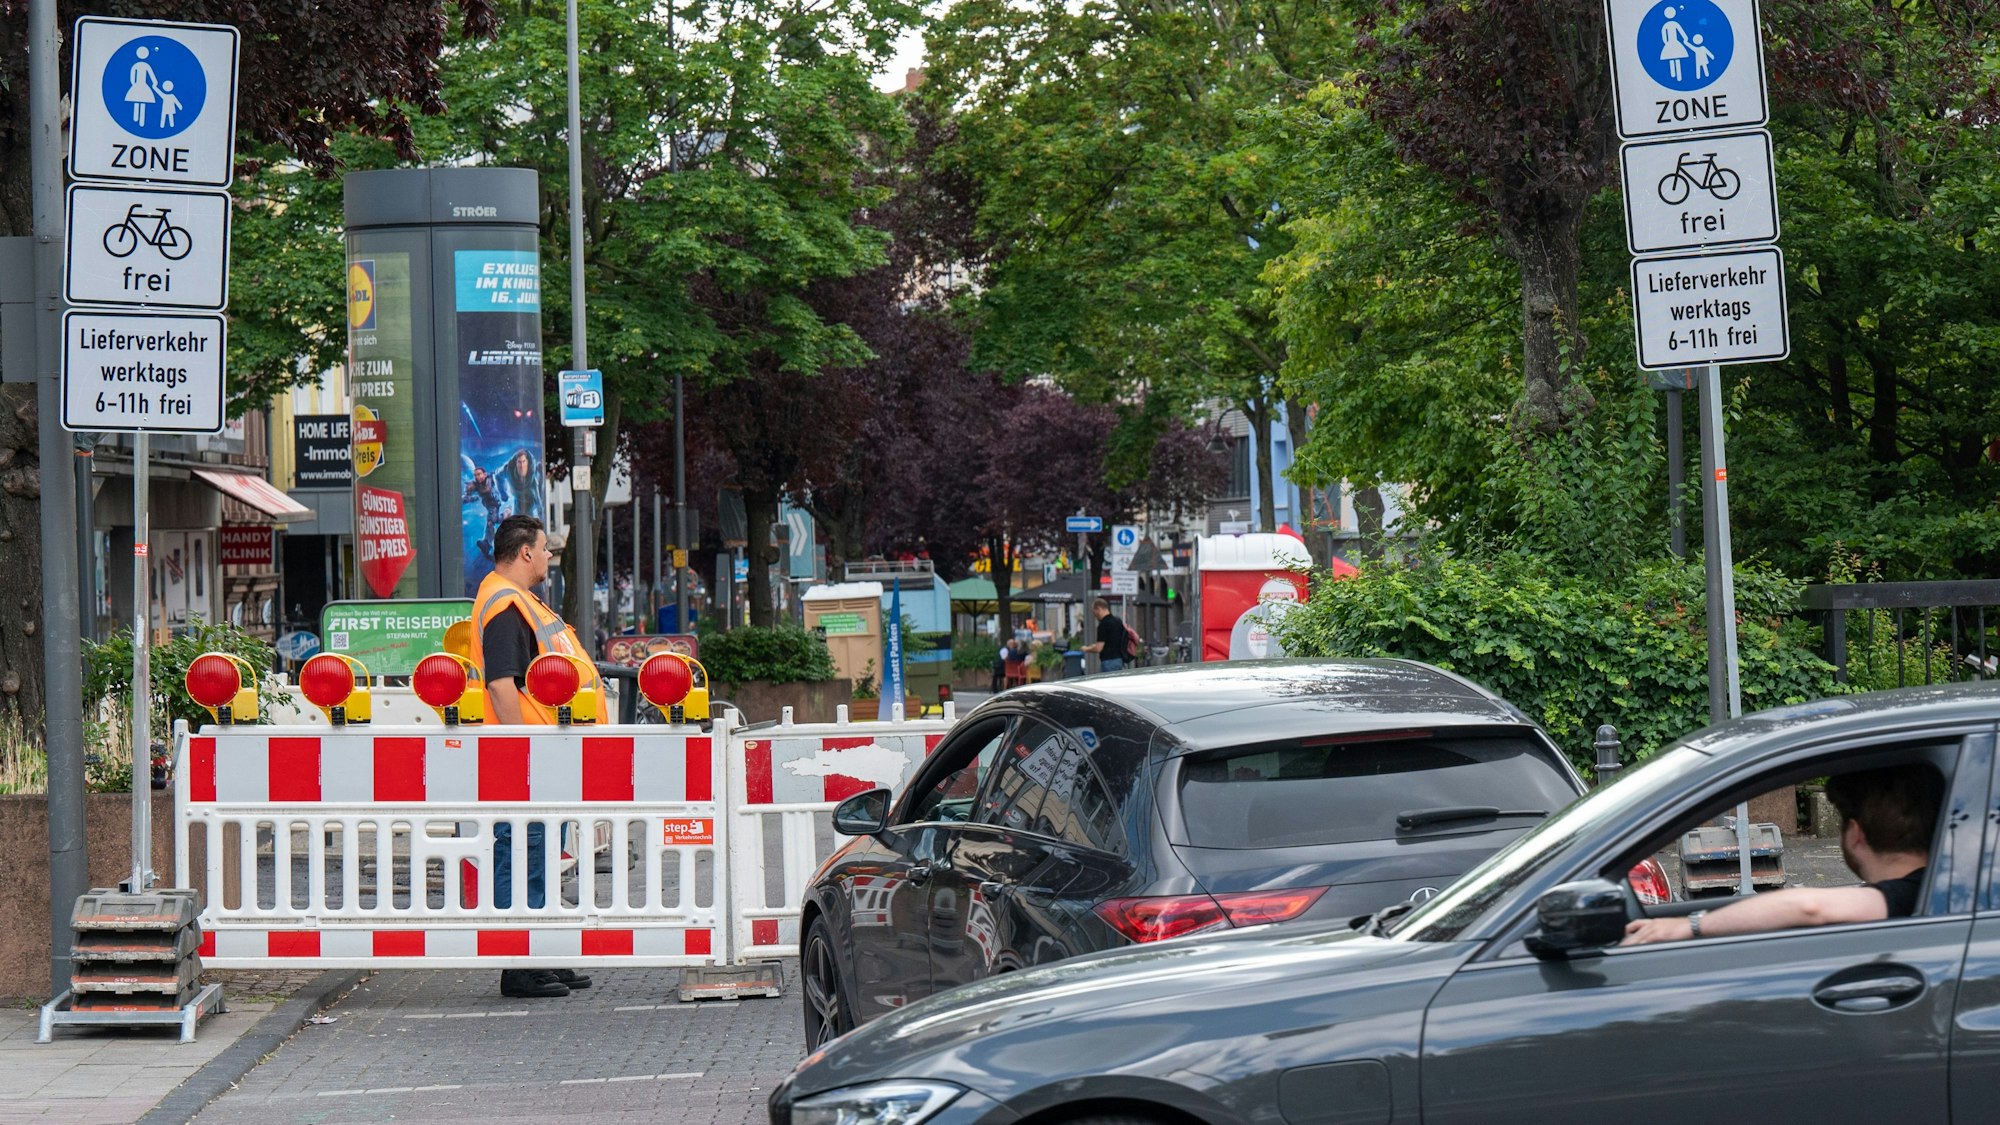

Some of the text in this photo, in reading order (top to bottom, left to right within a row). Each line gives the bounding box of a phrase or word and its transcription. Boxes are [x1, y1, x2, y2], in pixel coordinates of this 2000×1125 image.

[1656, 95, 1728, 123] ZONE
[111, 143, 189, 172] ZONE
[453, 206, 497, 217] STRÖER
[1680, 208, 1725, 234] frei
[123, 266, 171, 292] frei
[476, 277, 498, 289] IM
[502, 277, 533, 289] KINO
[1649, 265, 1767, 293] Lieferverkehr
[491, 291, 513, 304] 16.
[1670, 298, 1751, 321] werktags
[80, 328, 208, 352] Lieferverkehr
[364, 335, 377, 346] sich
[1668, 324, 1757, 350] 6-11h frei
[101, 361, 187, 389] werktags
[367, 359, 393, 376] ZUM
[361, 381, 394, 397] PREIS
[95, 391, 191, 415] 6-11h frei
[299, 422, 349, 439] HOME LIFE
[362, 489, 398, 514] GÜNSTIG
[360, 511, 406, 535] GÜNSTIGER
[222, 532, 271, 543] HANDY
[222, 548, 271, 559] KLINIK
[361, 538, 408, 562] LIDL-PREIS
[328, 617, 381, 630] FIRST
[889, 623, 899, 657] Parken
[891, 658, 900, 682] statt
[665, 823, 688, 835] step
